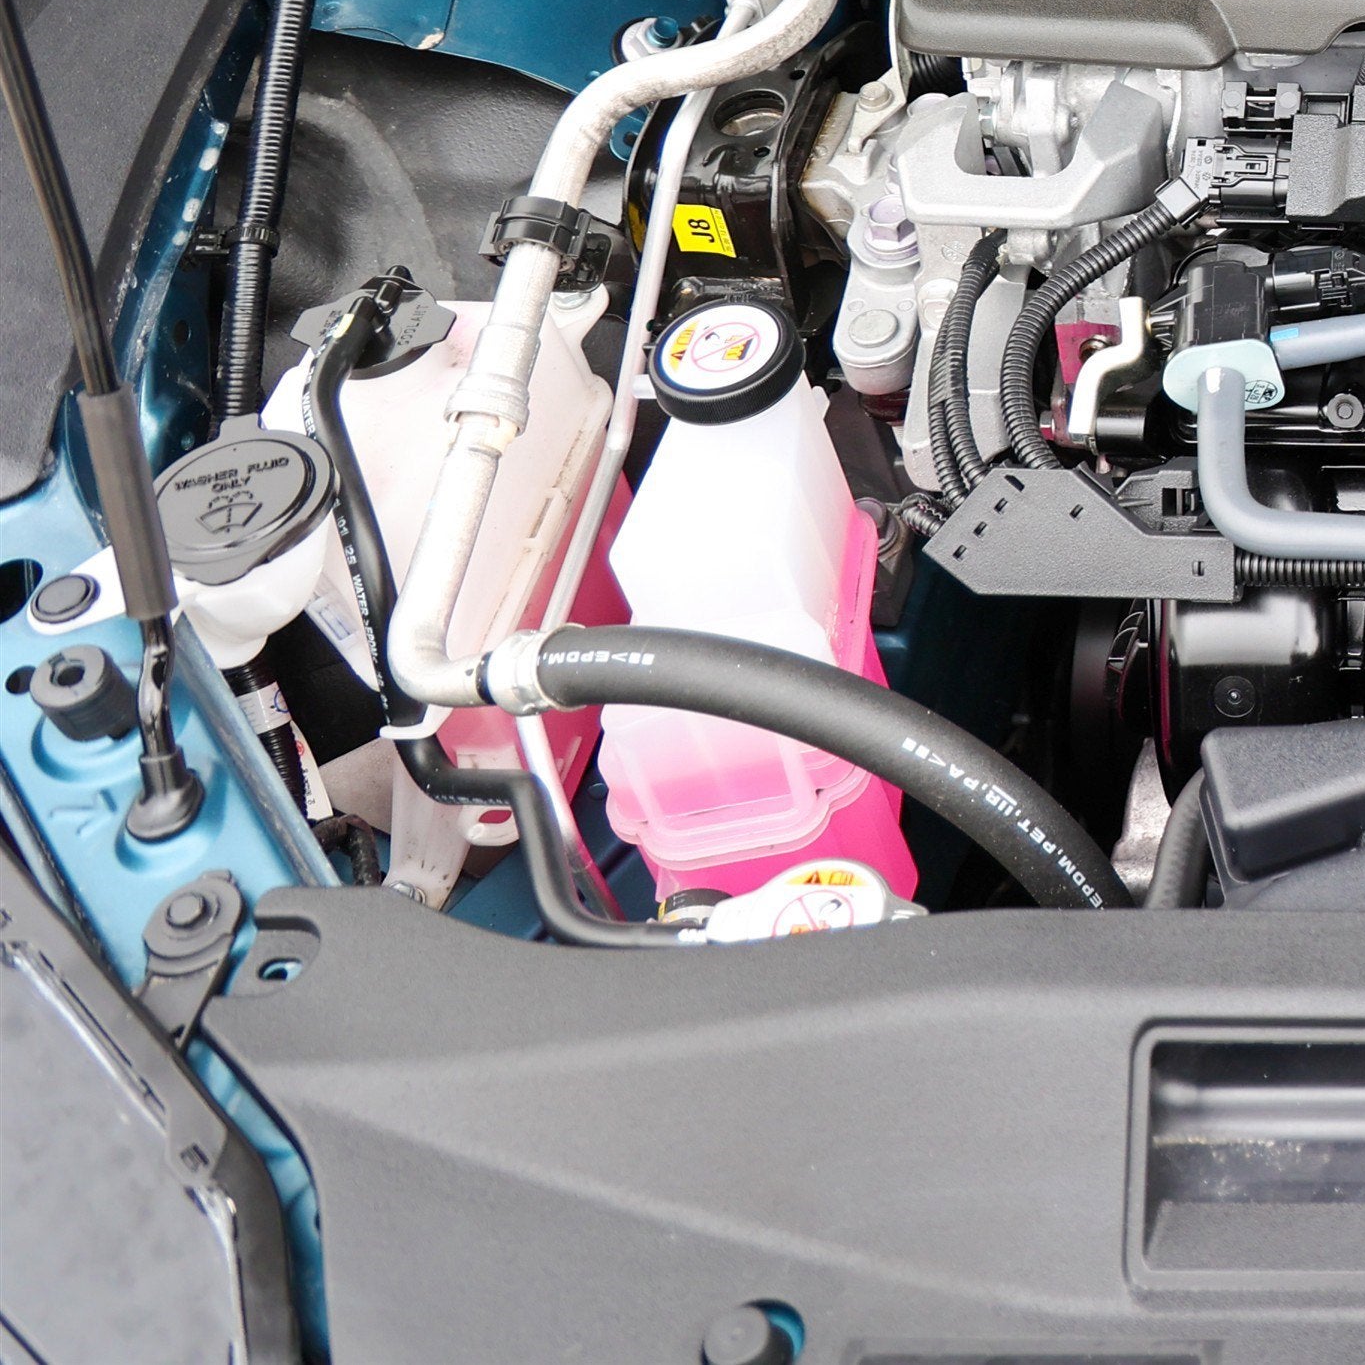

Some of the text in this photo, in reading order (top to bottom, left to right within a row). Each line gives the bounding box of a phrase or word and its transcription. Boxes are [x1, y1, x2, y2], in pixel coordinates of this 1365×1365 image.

[687, 218, 715, 244] J8
[397, 303, 430, 347] COOLANT
[301, 391, 317, 437] WATER
[174, 456, 291, 492] WASHER FLUID
[211, 475, 252, 493] ONLY
[352, 573, 370, 617] WATER
